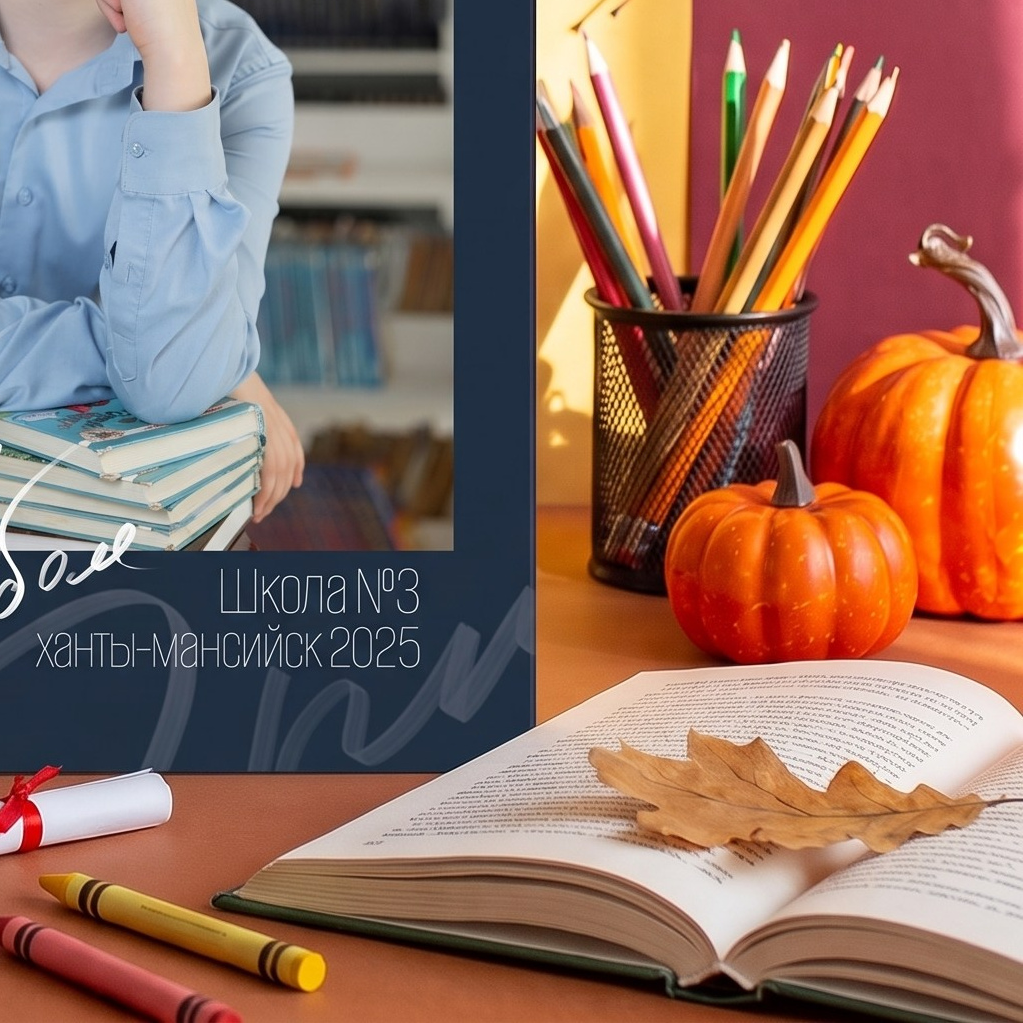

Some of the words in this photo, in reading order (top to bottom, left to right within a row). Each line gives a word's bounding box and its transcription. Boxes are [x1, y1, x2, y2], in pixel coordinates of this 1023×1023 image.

[219, 567, 347, 615] Школа
[356, 567, 421, 615] №3
[329, 625, 421, 669] 2025
